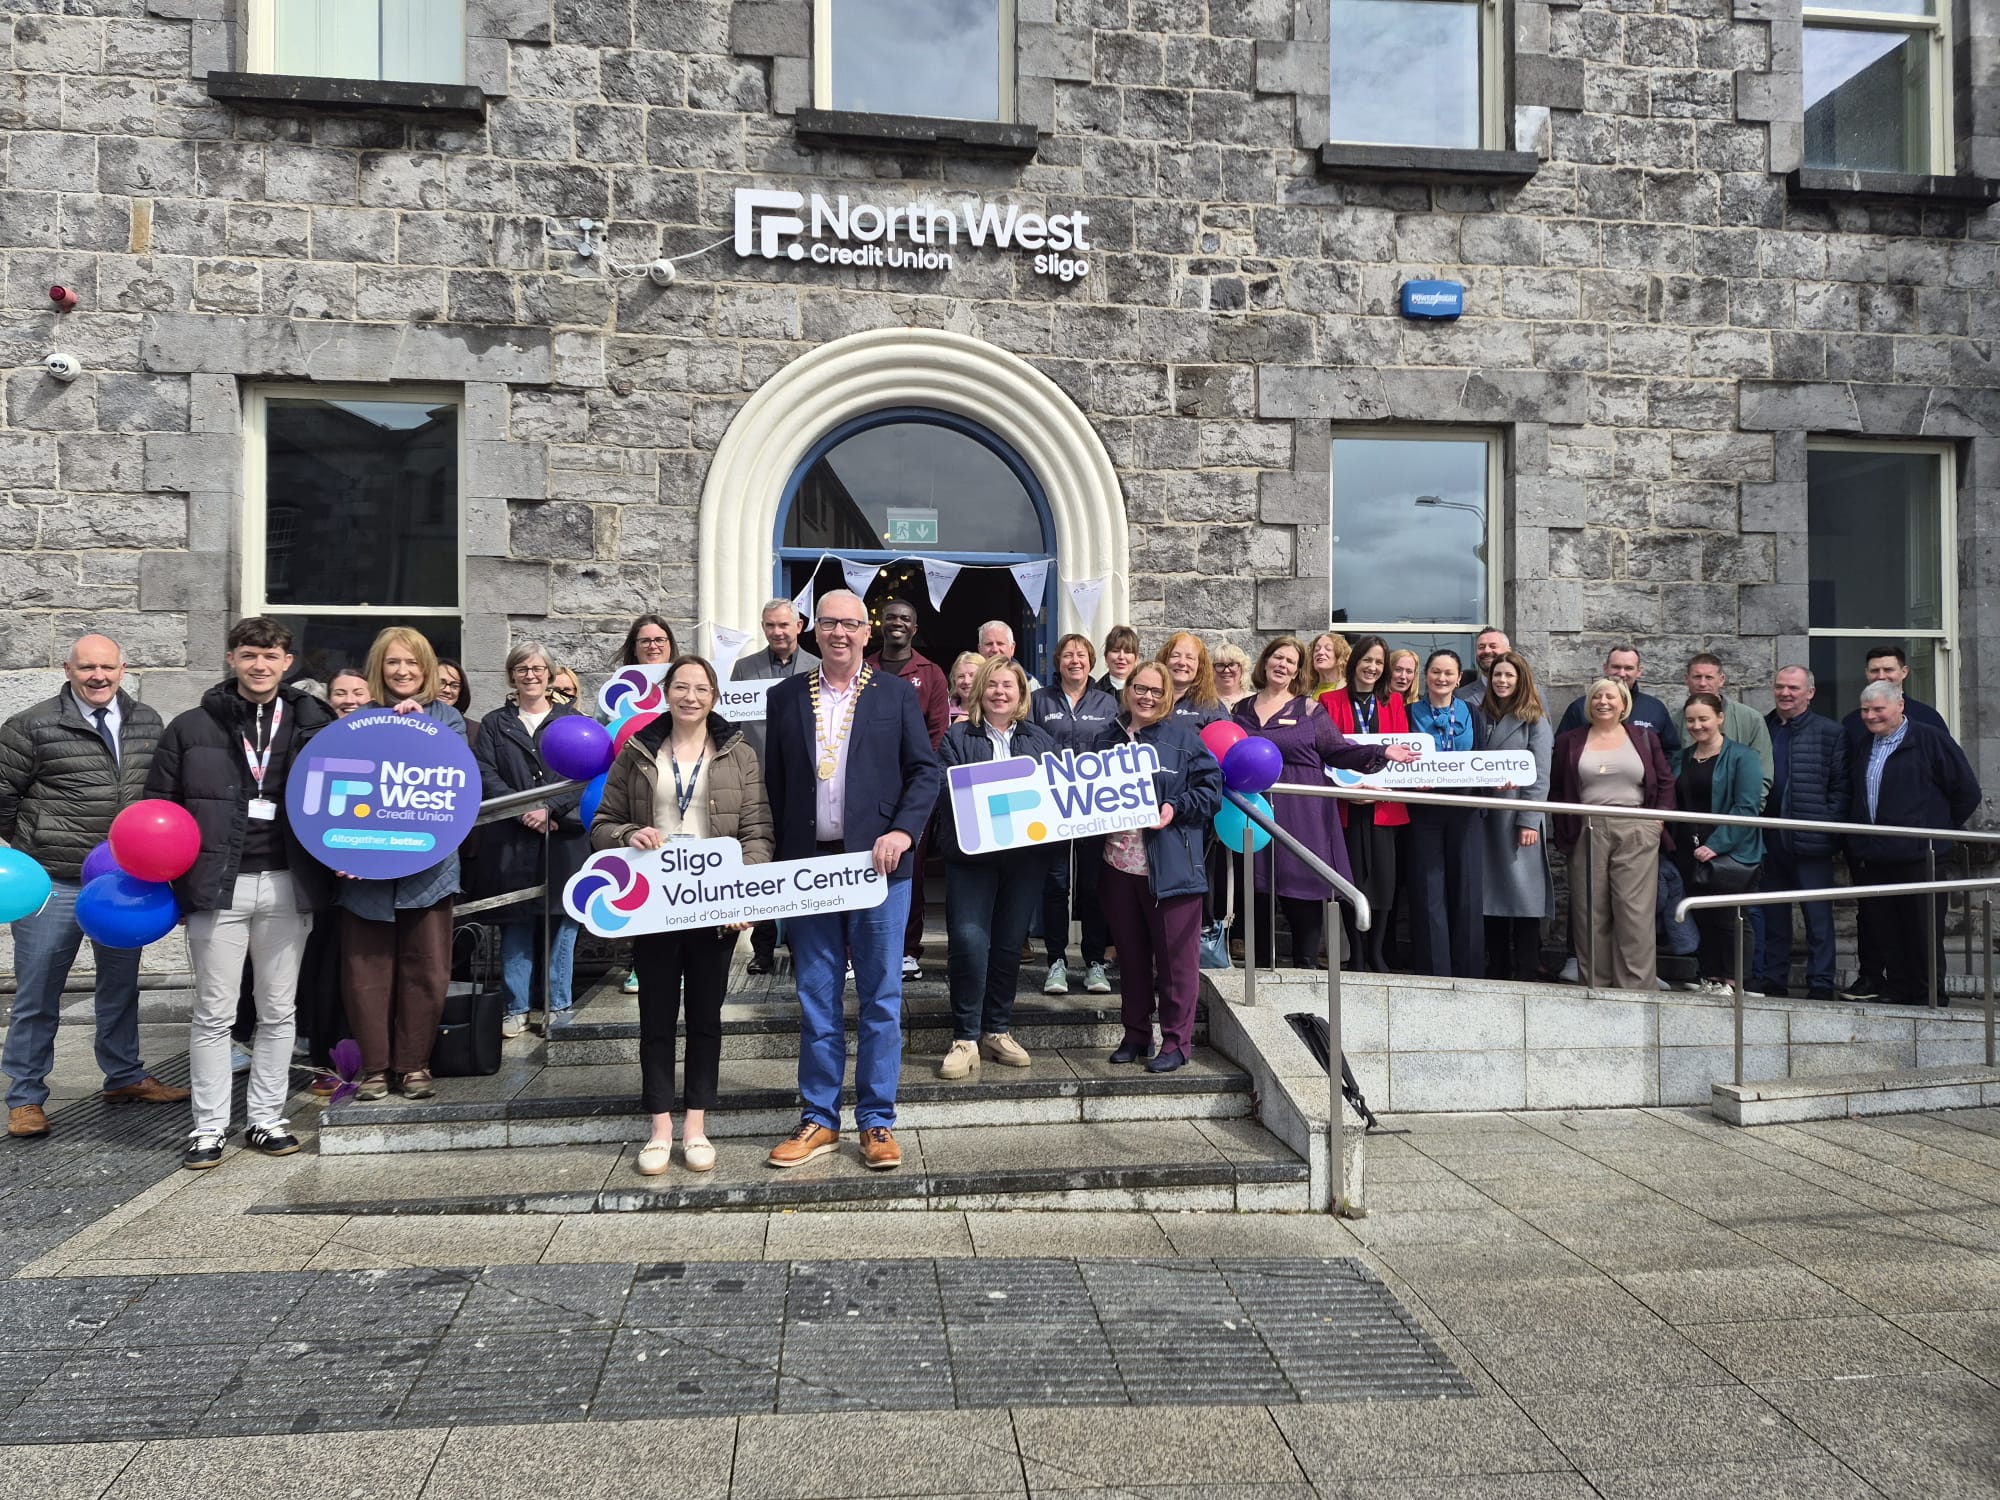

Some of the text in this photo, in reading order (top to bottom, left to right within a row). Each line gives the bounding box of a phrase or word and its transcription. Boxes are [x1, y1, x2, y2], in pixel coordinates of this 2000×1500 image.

[811, 193, 1090, 251] North West
[810, 242, 953, 271] Credit Union
[1033, 254, 1090, 282] Sligo
[347, 715, 438, 737] www.nwcu.ie
[379, 760, 466, 788] North
[1043, 743, 1158, 786] North
[1470, 756, 1530, 772] Centre
[379, 783, 457, 811] West
[1050, 777, 1155, 819] West
[376, 808, 454, 823] Credit Union
[1056, 810, 1159, 838] Credit Union
[330, 834, 427, 847] Altogether, better.
[660, 848, 722, 875] Sligo
[662, 866, 878, 906] Volunteer Centre
[665, 911, 696, 926] Ionad
[743, 900, 798, 919] Dheonach
[800, 894, 845, 911] Sligeach
